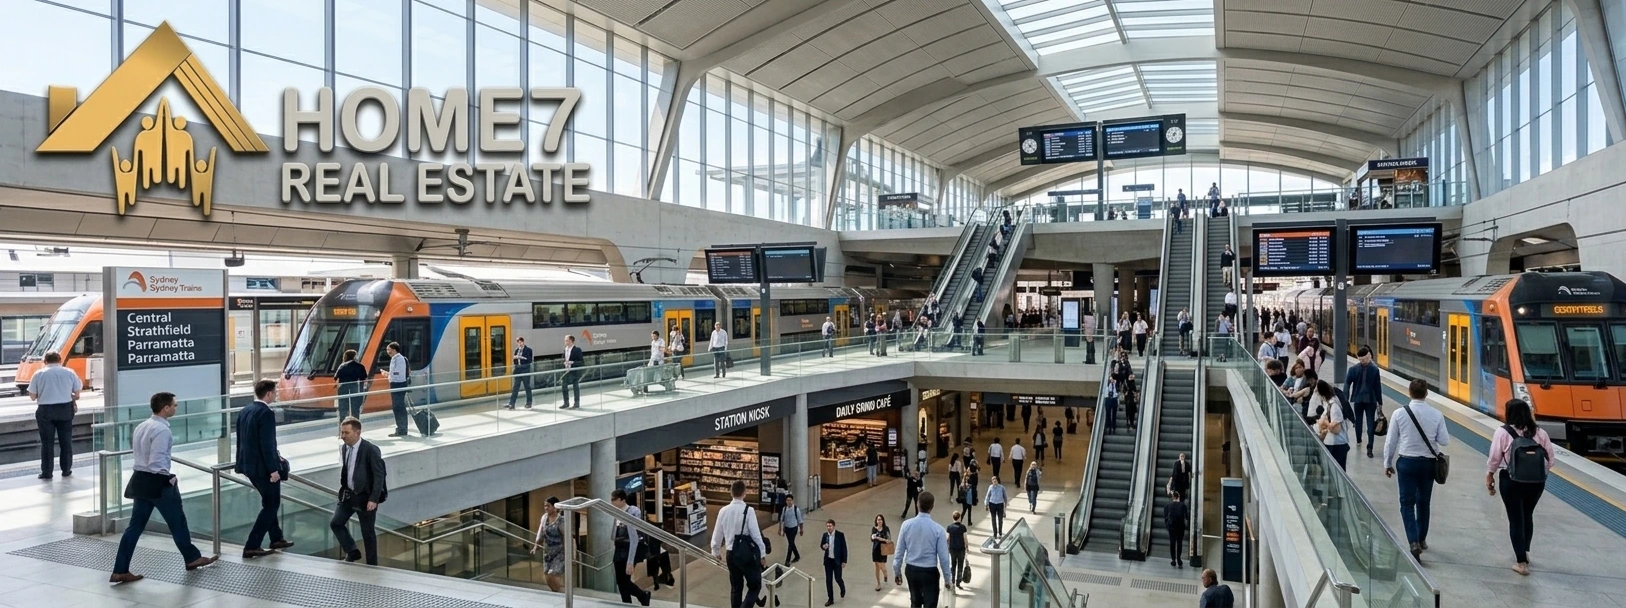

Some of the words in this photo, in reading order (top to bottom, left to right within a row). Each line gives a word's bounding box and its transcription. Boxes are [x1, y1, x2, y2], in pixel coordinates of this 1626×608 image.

[149, 275, 179, 284] Sydney
[149, 284, 179, 293] Sydney
[179, 284, 203, 292] Trains
[127, 312, 172, 324] Central
[127, 324, 191, 337] Strathfield
[127, 338, 195, 351] Parramatta
[127, 351, 195, 364] Parramatta
[836, 404, 855, 418] DAILY
[876, 394, 892, 409] CAFÉ
[714, 411, 747, 431] STATION
